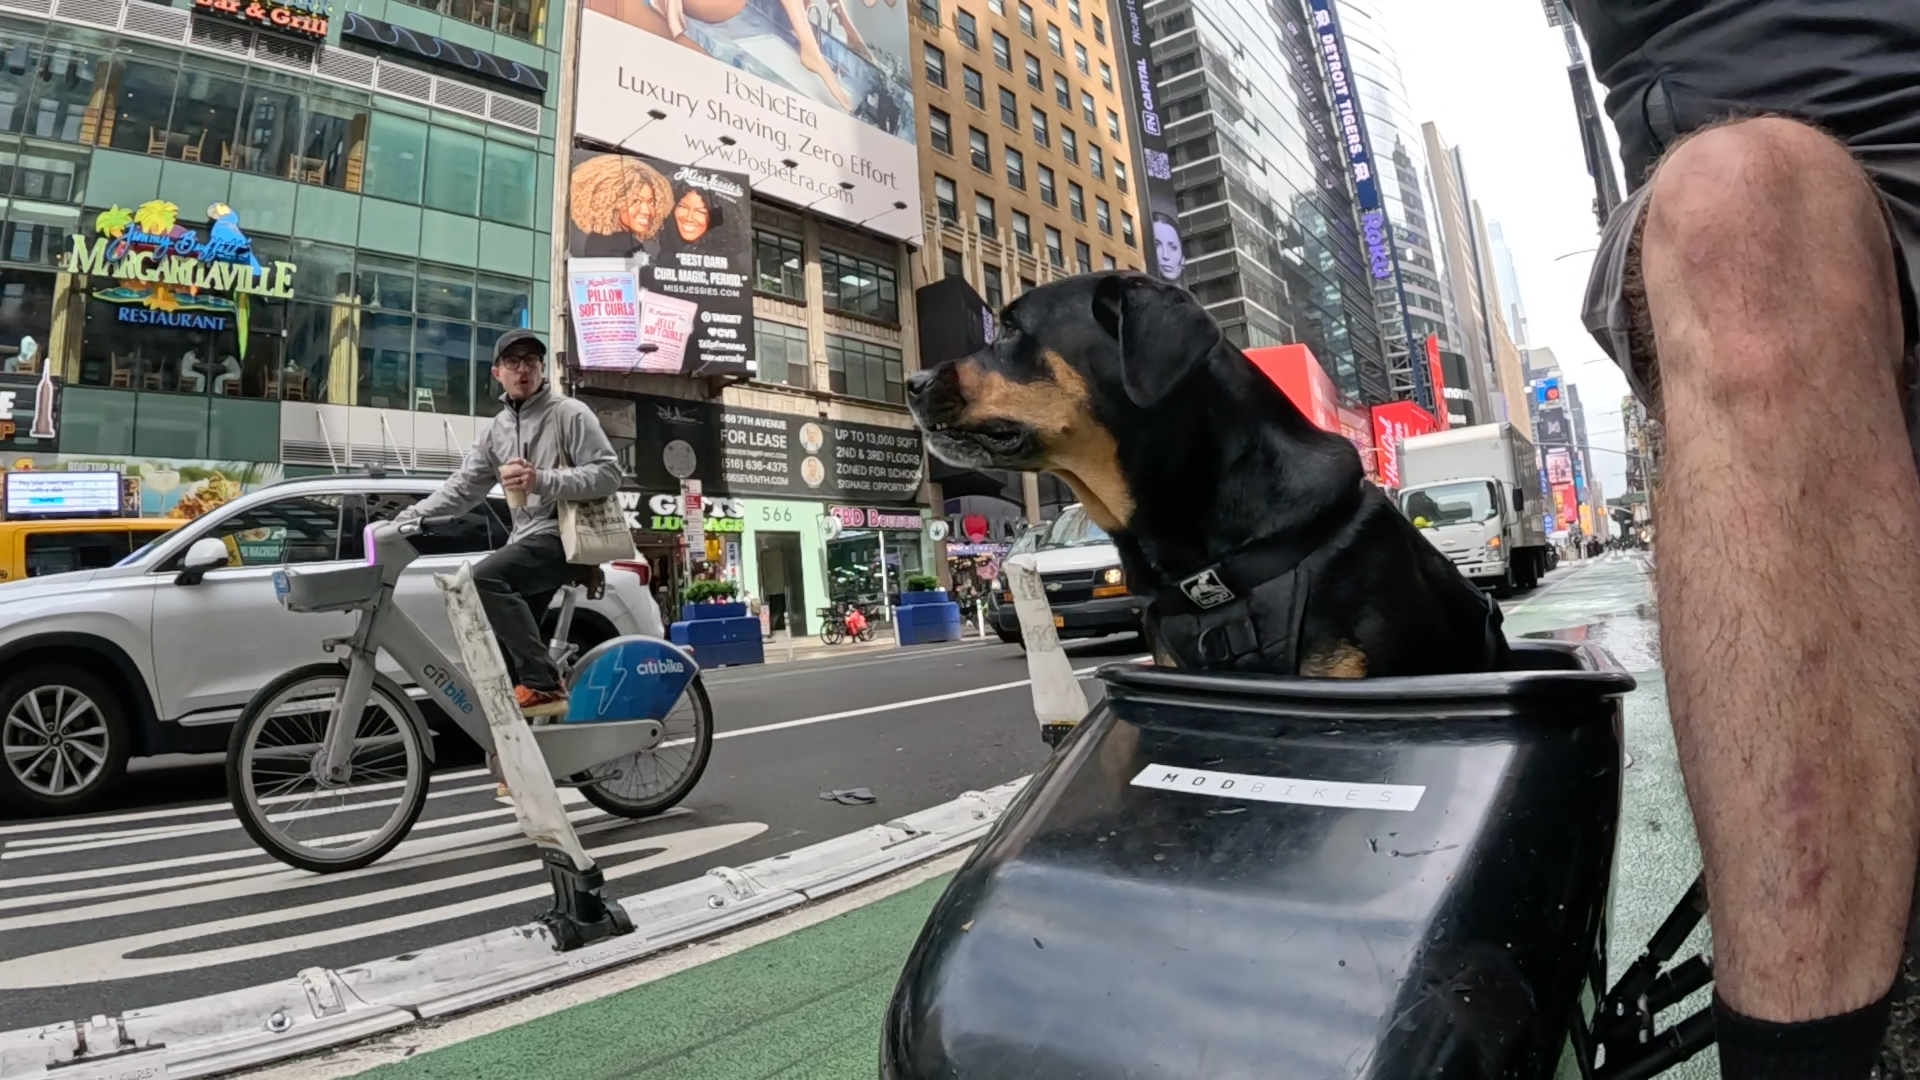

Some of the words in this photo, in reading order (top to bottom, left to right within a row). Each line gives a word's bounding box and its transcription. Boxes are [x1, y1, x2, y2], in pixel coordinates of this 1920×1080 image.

[245, 3, 266, 20] &
[270, 8, 328, 36] Grill
[1321, 34, 1349, 95] DETROIT
[1137, 58, 1153, 110] CAPITAL
[725, 71, 818, 129] PosheEra
[618, 67, 699, 118] Luxury
[707, 100, 792, 151] Shaving,
[799, 134, 844, 168] Zero
[850, 155, 898, 190] Effort
[673, 167, 708, 187] Miss
[684, 134, 855, 204] www.PosheEra.com
[105, 223, 174, 262] Jimmy
[67, 234, 298, 299] MARGARITAVILLE
[703, 256, 728, 270] DARN
[654, 267, 677, 281] CURL
[678, 269, 709, 285] MAGIC,
[587, 288, 623, 302] PILLOW
[663, 284, 740, 298] MISSJESSIES.COM
[579, 303, 601, 317] SOFT
[605, 302, 635, 316] CURLS
[118, 306, 227, 332] RESTAURANT
[655, 318, 676, 330] JELLY
[711, 313, 742, 325] TARGET
[717, 328, 737, 339] CVS
[736, 415, 754, 426] 7TH
[754, 417, 787, 430] AVENUE
[720, 429, 747, 445] FOR
[749, 431, 787, 449] LEASE
[835, 428, 849, 441] UP
[850, 430, 865, 443] TO
[866, 432, 895, 446] 13,000
[835, 446, 857, 459] 2ND
[858, 448, 865, 460] &
[866, 449, 885, 462] 3RD
[886, 451, 920, 466] FLOORS
[836, 463, 868, 476] ZONED
[868, 465, 887, 477] FOR
[837, 479, 871, 490] SIGNAGE
[762, 506, 792, 522] 566
[831, 507, 864, 527] CBD
[651, 516, 744, 532] LUAGE
